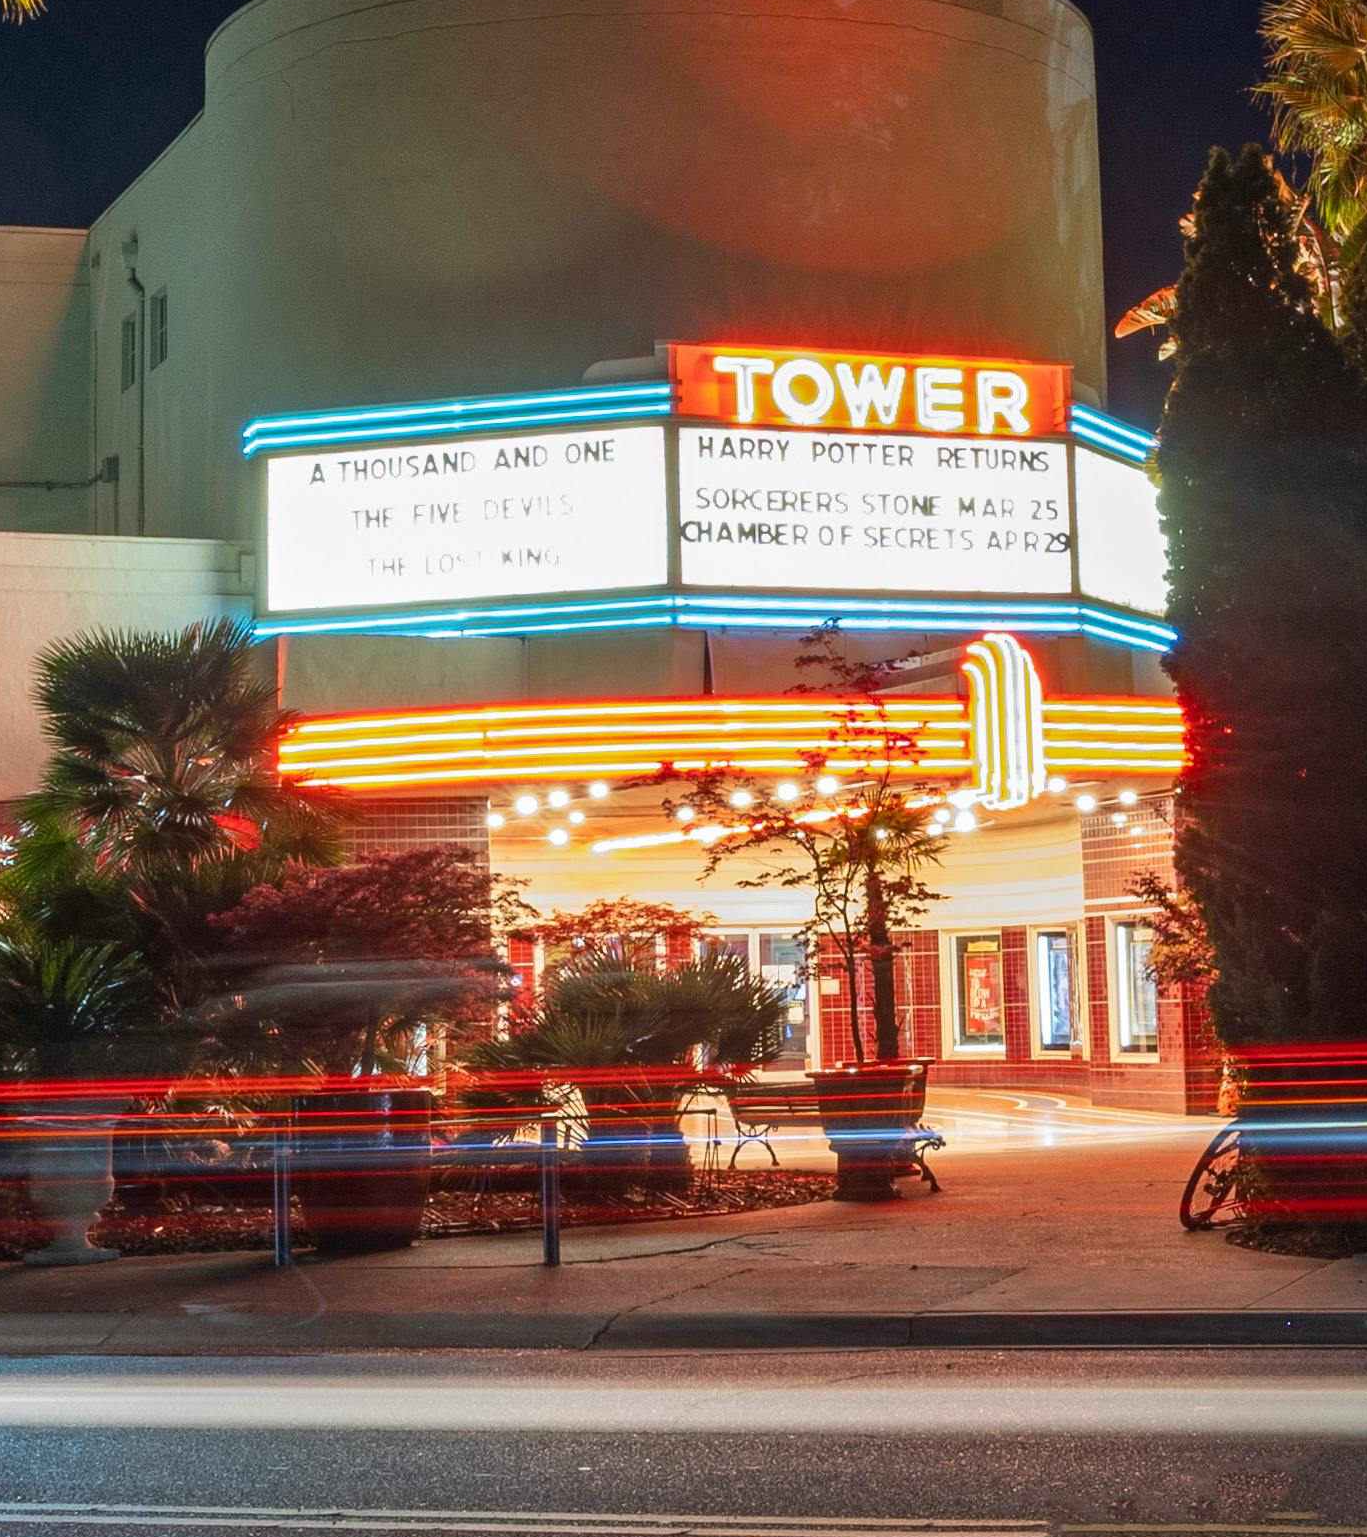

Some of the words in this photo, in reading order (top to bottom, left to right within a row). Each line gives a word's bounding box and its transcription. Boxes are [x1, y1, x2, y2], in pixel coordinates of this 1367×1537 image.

[713, 356, 1031, 434] TOWER
[309, 463, 326, 485] A
[337, 451, 476, 483] THOUSAND
[493, 444, 548, 470] AND
[565, 439, 616, 464] ONE
[698, 436, 790, 462] HARRY
[811, 440, 914, 467] POTTER
[937, 446, 1050, 472] RETURNS
[352, 507, 392, 530] THE
[413, 501, 463, 525] FIVE
[484, 493, 574, 520] DEVILS
[695, 487, 850, 515] SORCERERS
[862, 493, 942, 518] STONE
[958, 496, 1015, 519] MAR
[1031, 498, 1059, 521] 25
[680, 519, 808, 546] CHAMBER
[818, 524, 853, 547] OF
[863, 526, 974, 551] SECRETS
[987, 528, 1039, 551] APR
[1043, 531, 1071, 554] 29
[369, 556, 408, 577] THE
[501, 545, 560, 568] KING
